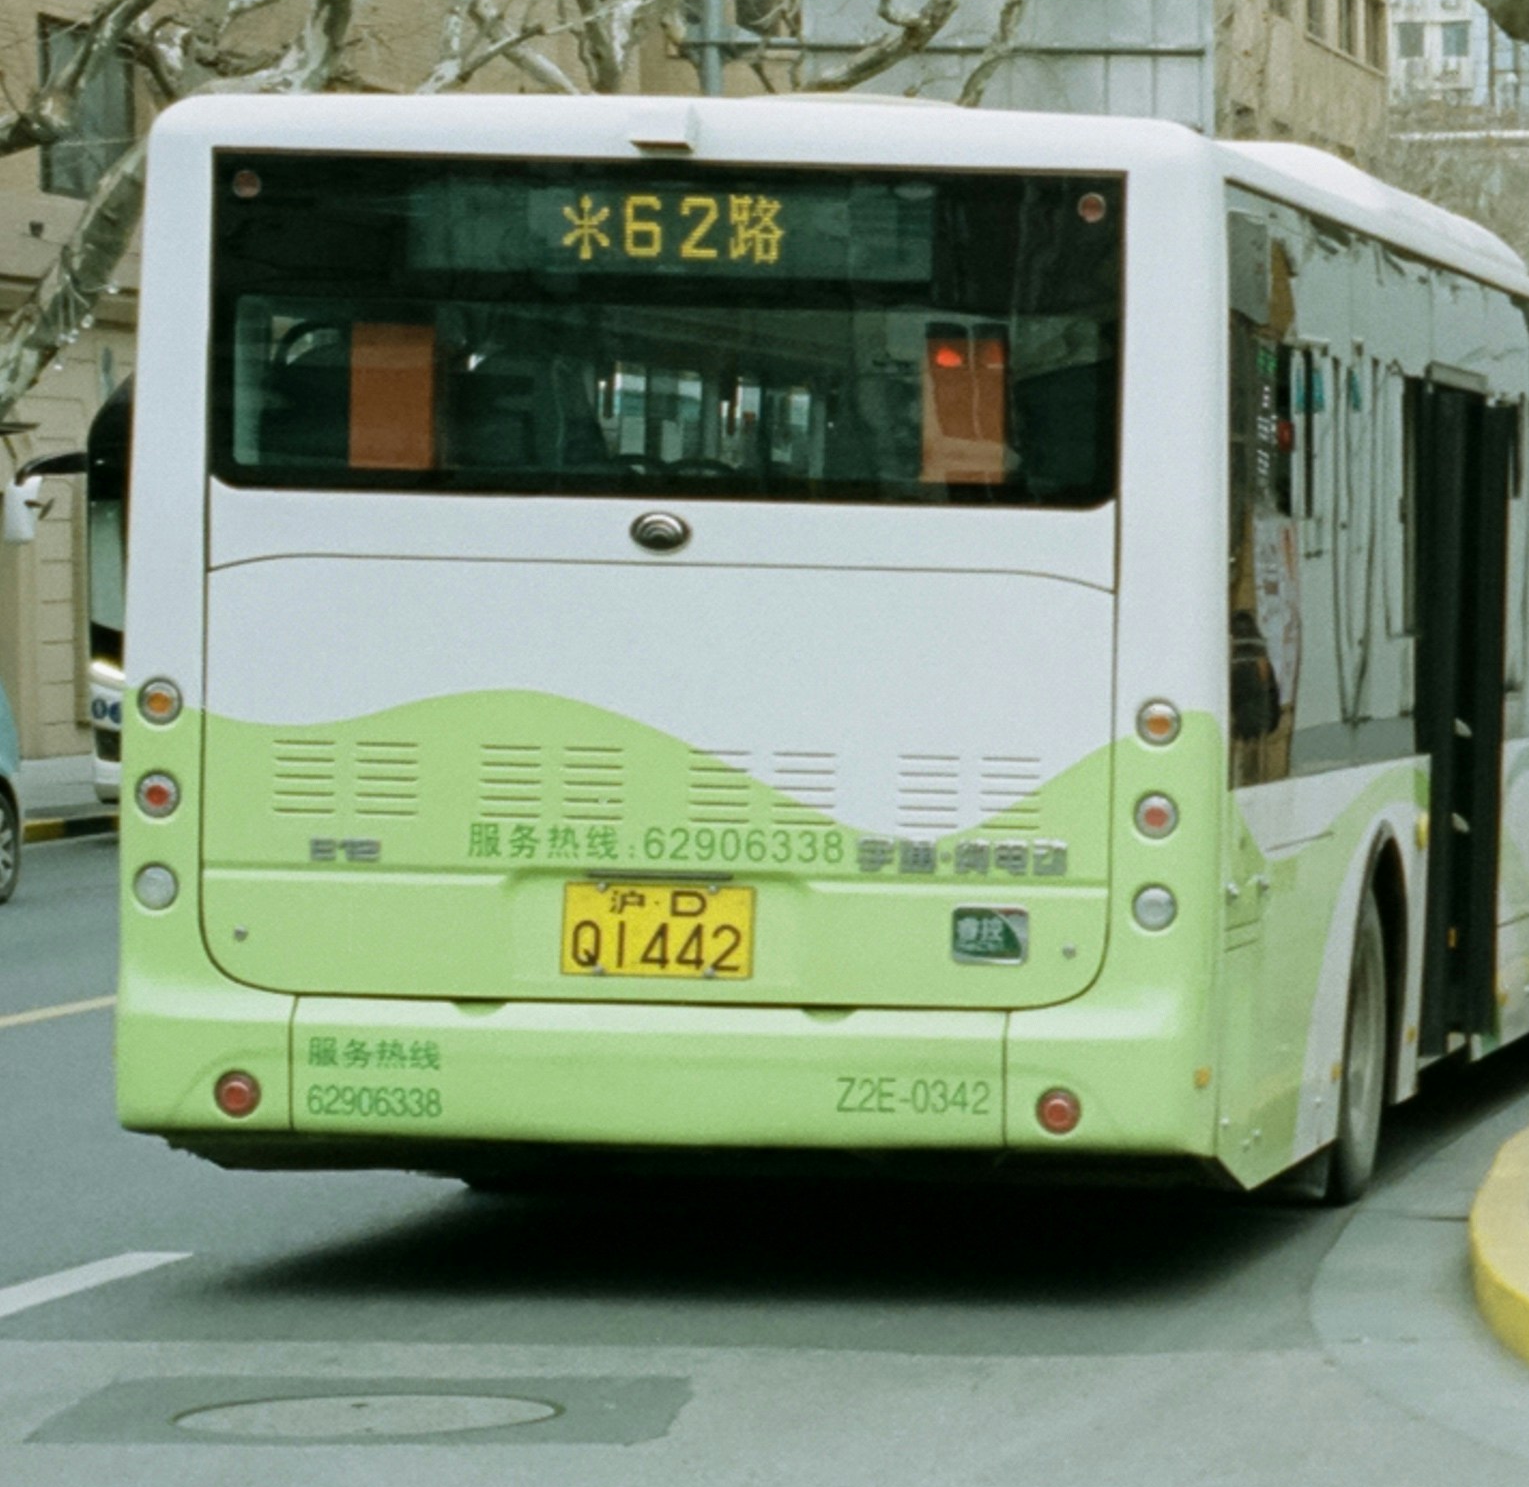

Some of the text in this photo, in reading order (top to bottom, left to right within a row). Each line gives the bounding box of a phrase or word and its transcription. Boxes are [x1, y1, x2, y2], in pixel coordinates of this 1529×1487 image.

[571, 920, 742, 972] Q1442
[307, 1036, 442, 1072] 服务热线
[307, 1084, 443, 1116] 62906338
[835, 1077, 991, 1116] Z2E-0342
